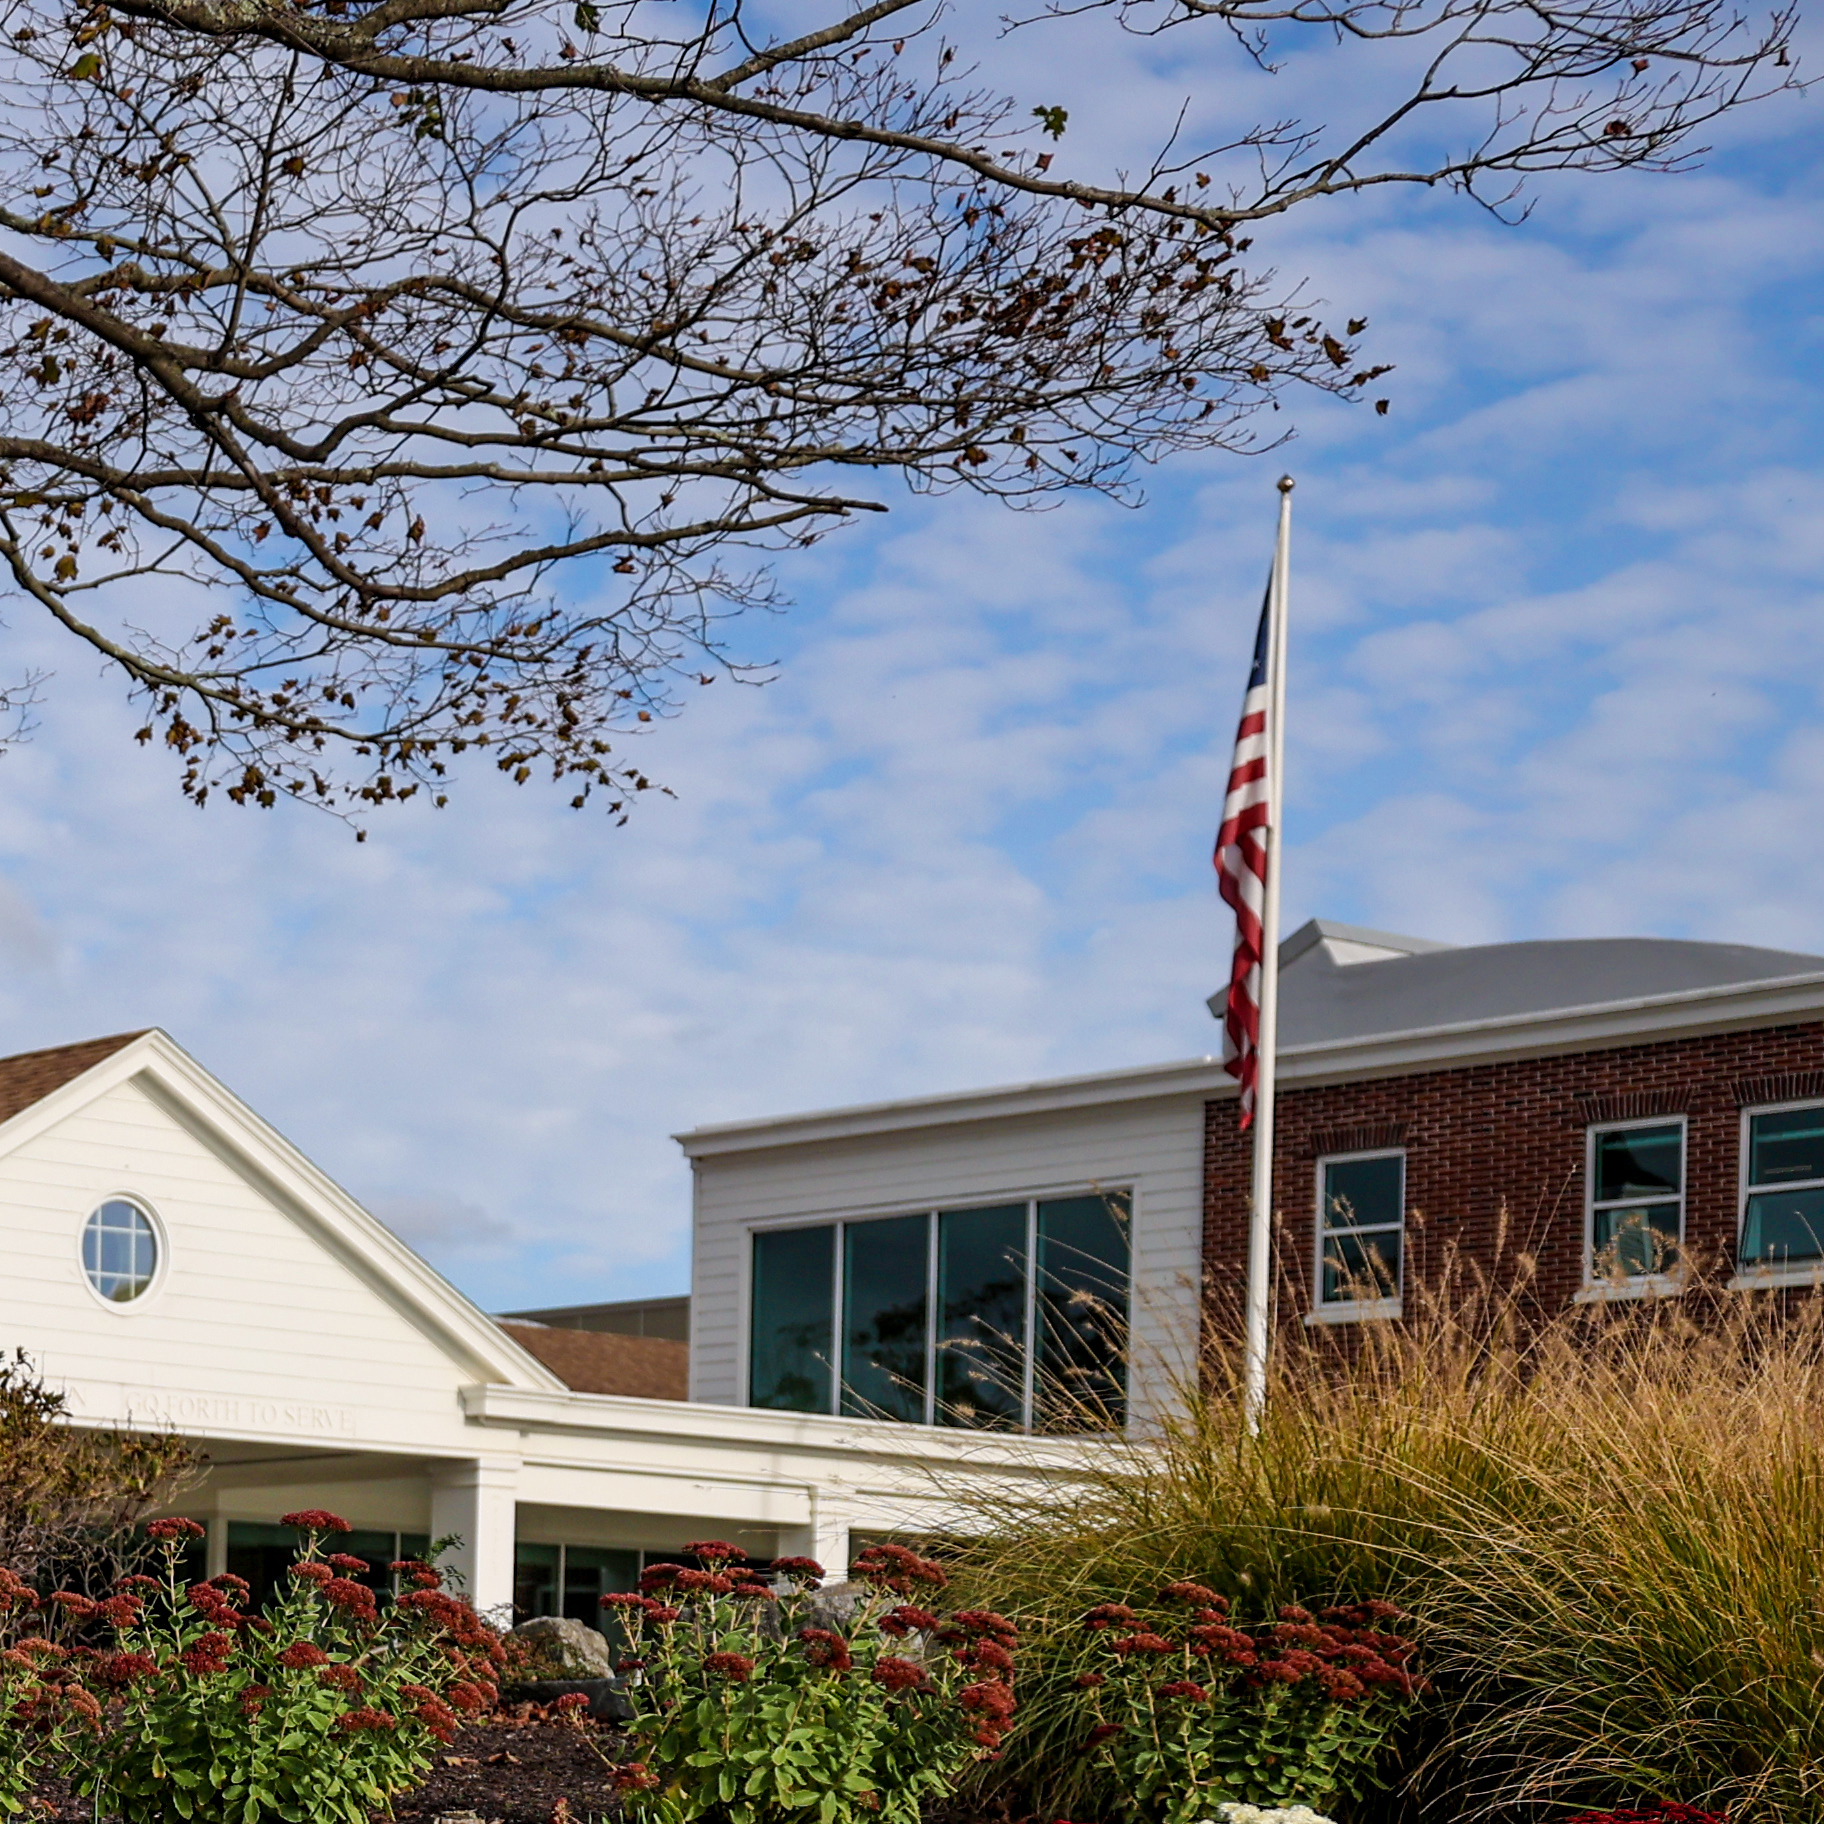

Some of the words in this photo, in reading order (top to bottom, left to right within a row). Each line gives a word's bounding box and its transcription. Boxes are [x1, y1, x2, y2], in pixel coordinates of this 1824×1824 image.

[125, 1390, 160, 1414] GO
[167, 1394, 240, 1421] FORTH
[250, 1402, 278, 1425] TO
[284, 1404, 355, 1431] SERVE
